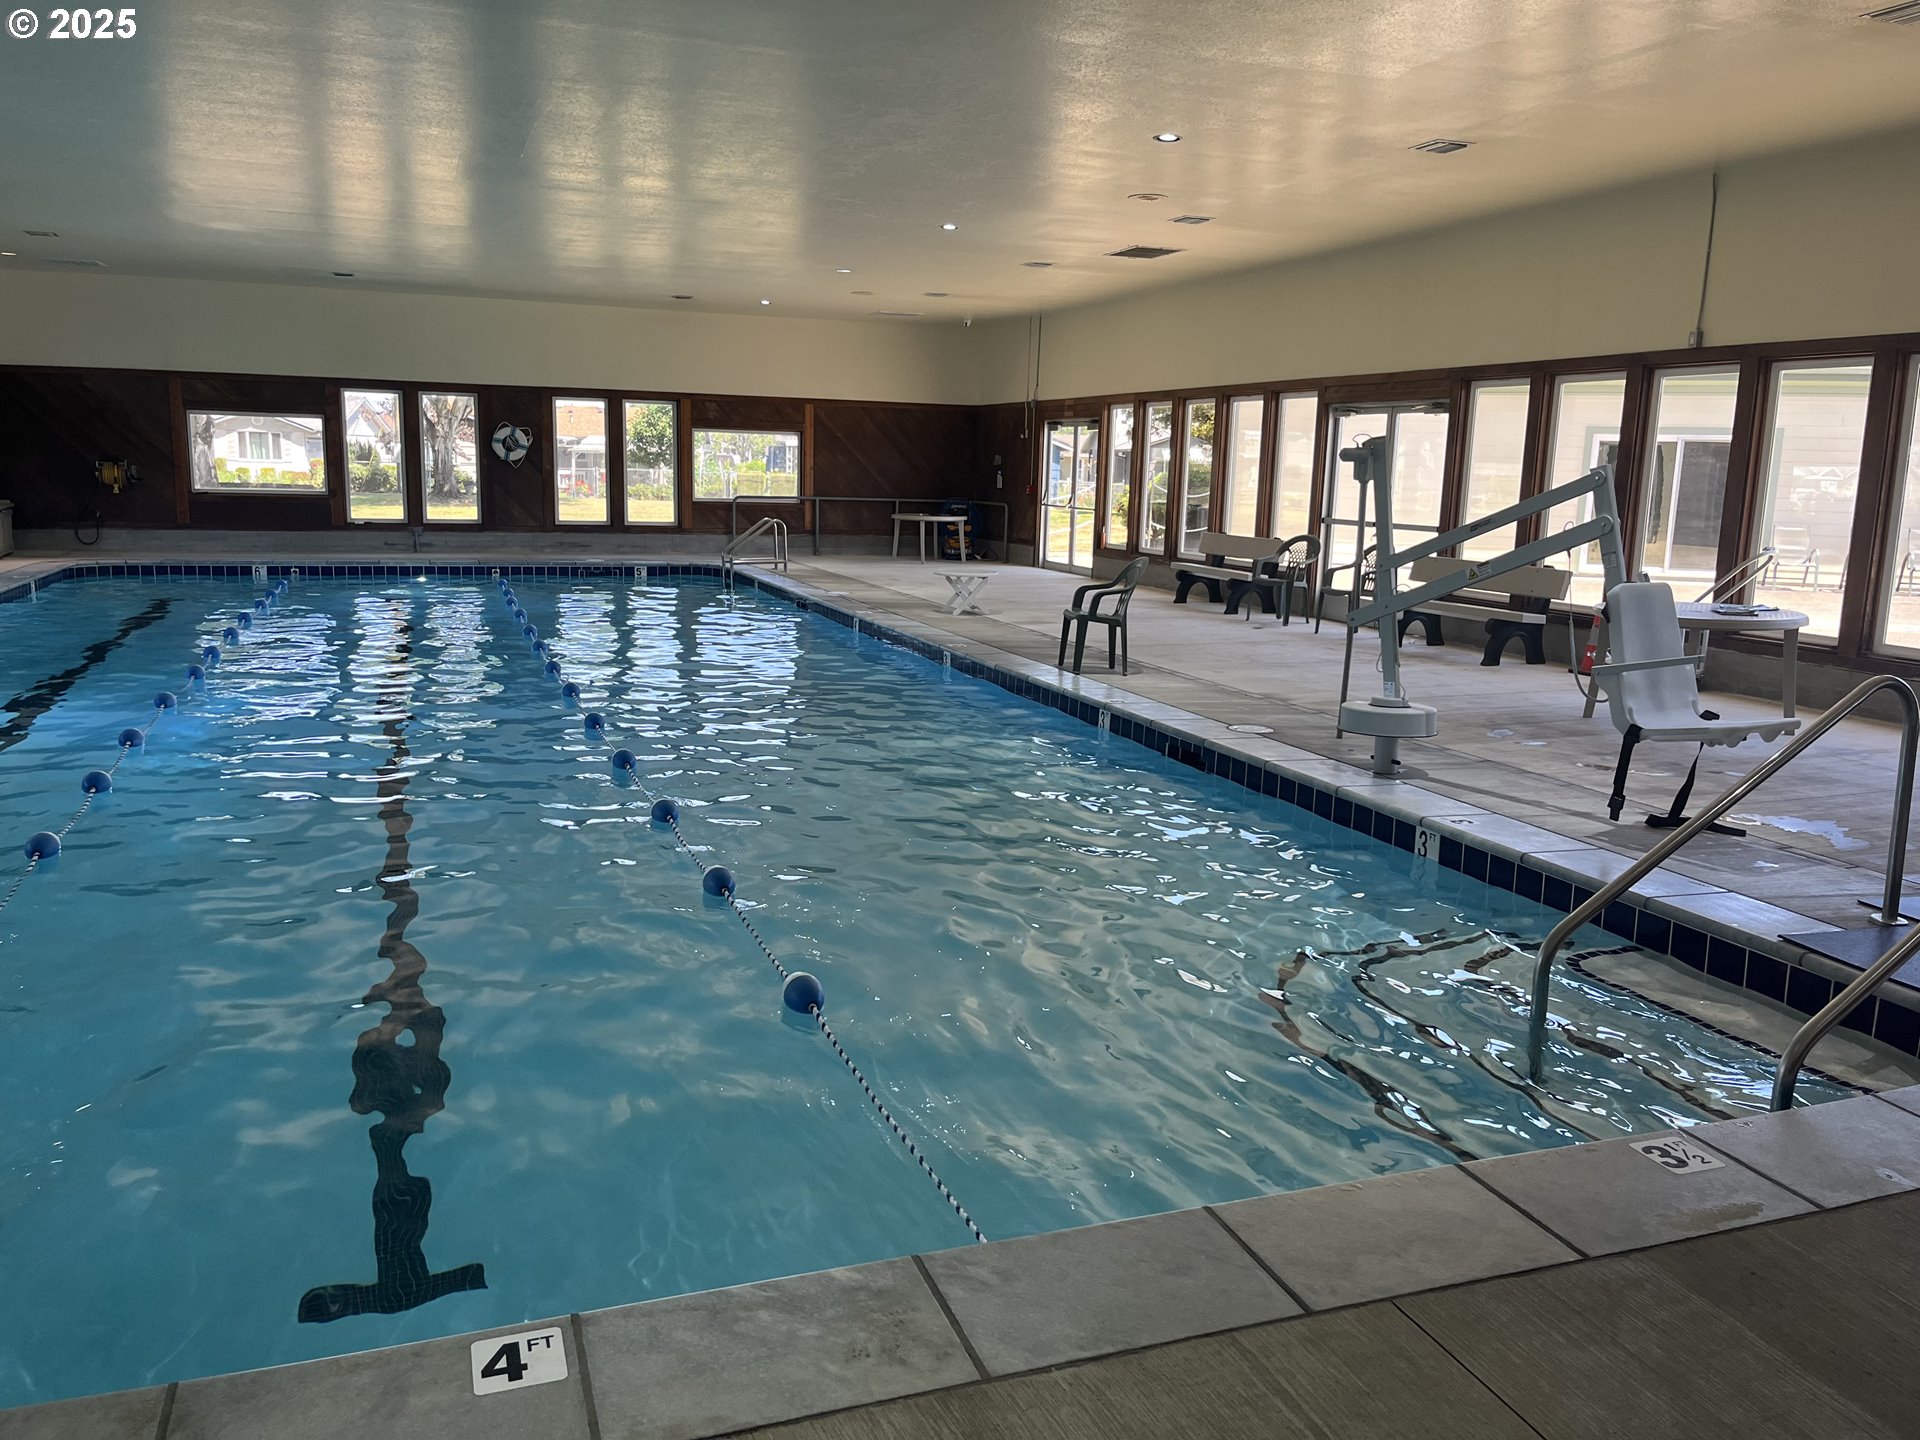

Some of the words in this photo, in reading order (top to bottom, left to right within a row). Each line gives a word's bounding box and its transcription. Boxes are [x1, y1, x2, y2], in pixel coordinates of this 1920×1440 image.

[1417, 830, 1428, 857] 3
[1429, 833, 1437, 843] FT
[1641, 1145, 1690, 1169] 3
[481, 1341, 528, 1382] 4
[526, 1335, 555, 1352] FT
